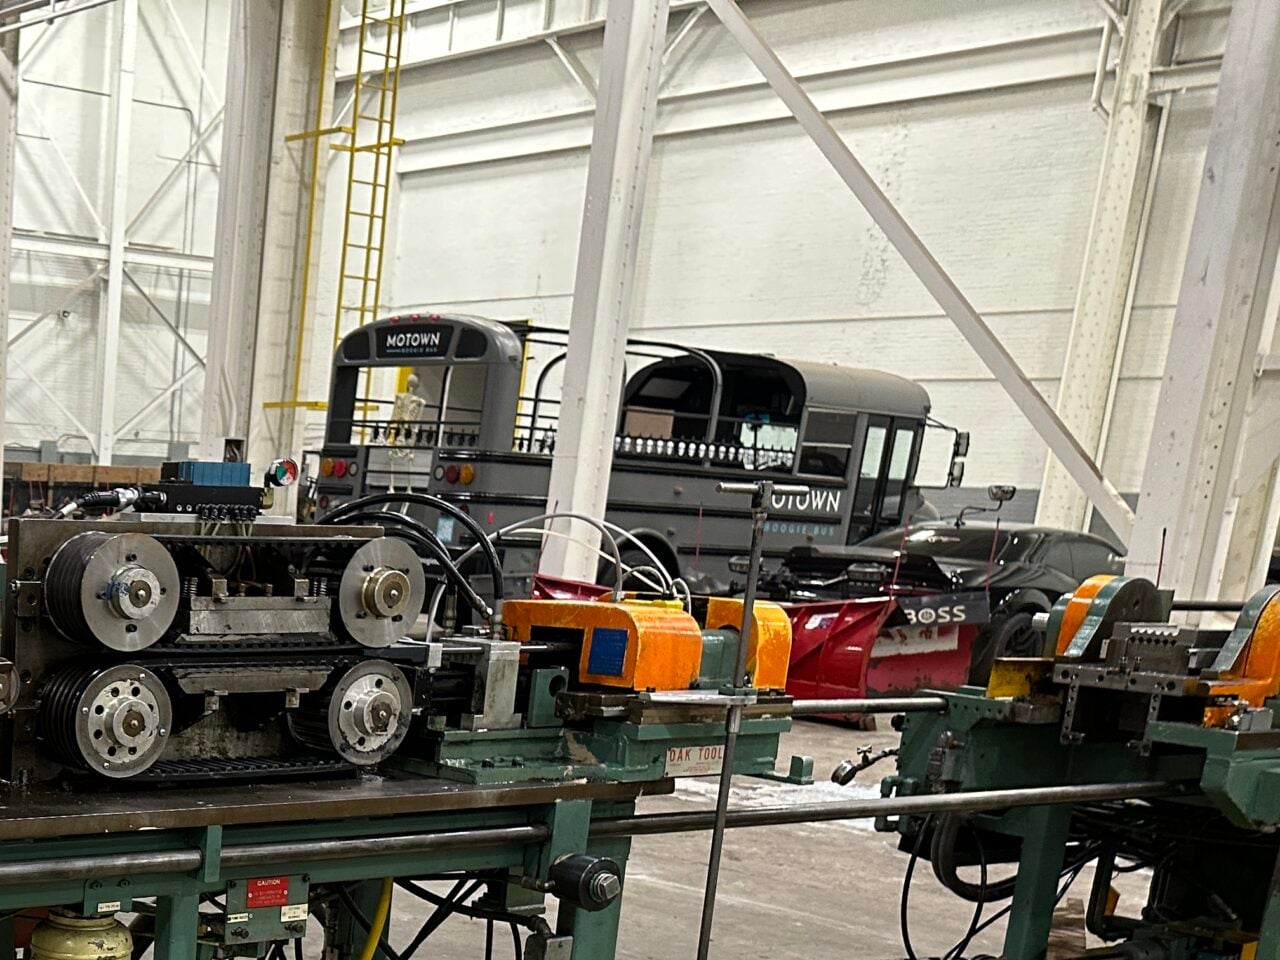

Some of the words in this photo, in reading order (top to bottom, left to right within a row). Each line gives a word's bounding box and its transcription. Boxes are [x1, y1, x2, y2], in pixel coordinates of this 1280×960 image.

[386, 332, 440, 347] MOTOWN
[771, 490, 840, 512] OTOWN
[763, 522, 807, 535] BOOGIE
[813, 526, 834, 537] BUS
[904, 605, 966, 625] BOSS
[670, 748, 691, 762] OAK
[257, 879, 281, 887] CAUTION
